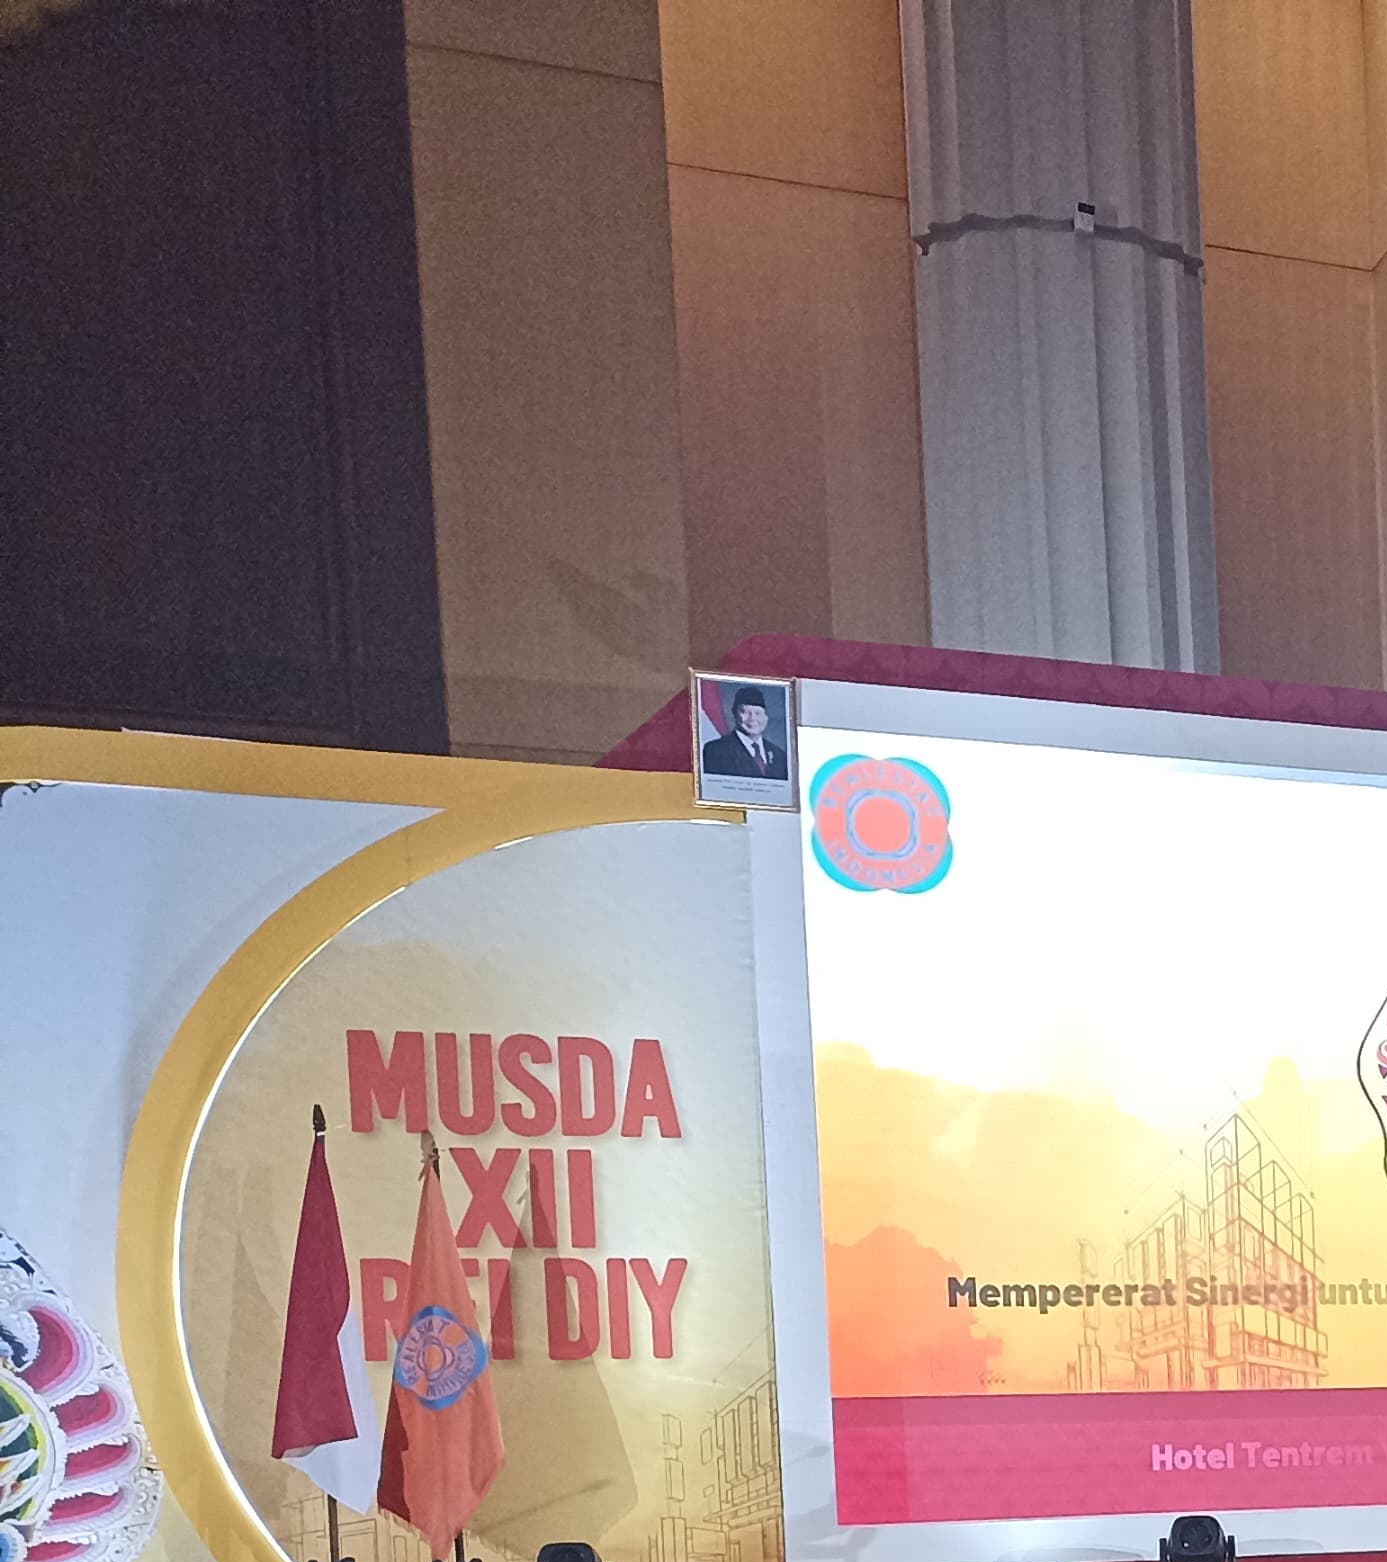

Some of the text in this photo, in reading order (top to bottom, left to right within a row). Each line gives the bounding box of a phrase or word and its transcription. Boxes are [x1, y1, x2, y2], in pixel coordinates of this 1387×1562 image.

[346, 1030, 682, 1139] MUSDA
[448, 1147, 597, 1249] XII
[545, 1257, 688, 1360] DIY
[947, 1275, 1177, 1314] Mempererat
[1185, 1275, 1310, 1314] Sinergi
[1151, 1442, 1235, 1472] Hotel
[1241, 1440, 1373, 1470] Tentrem
